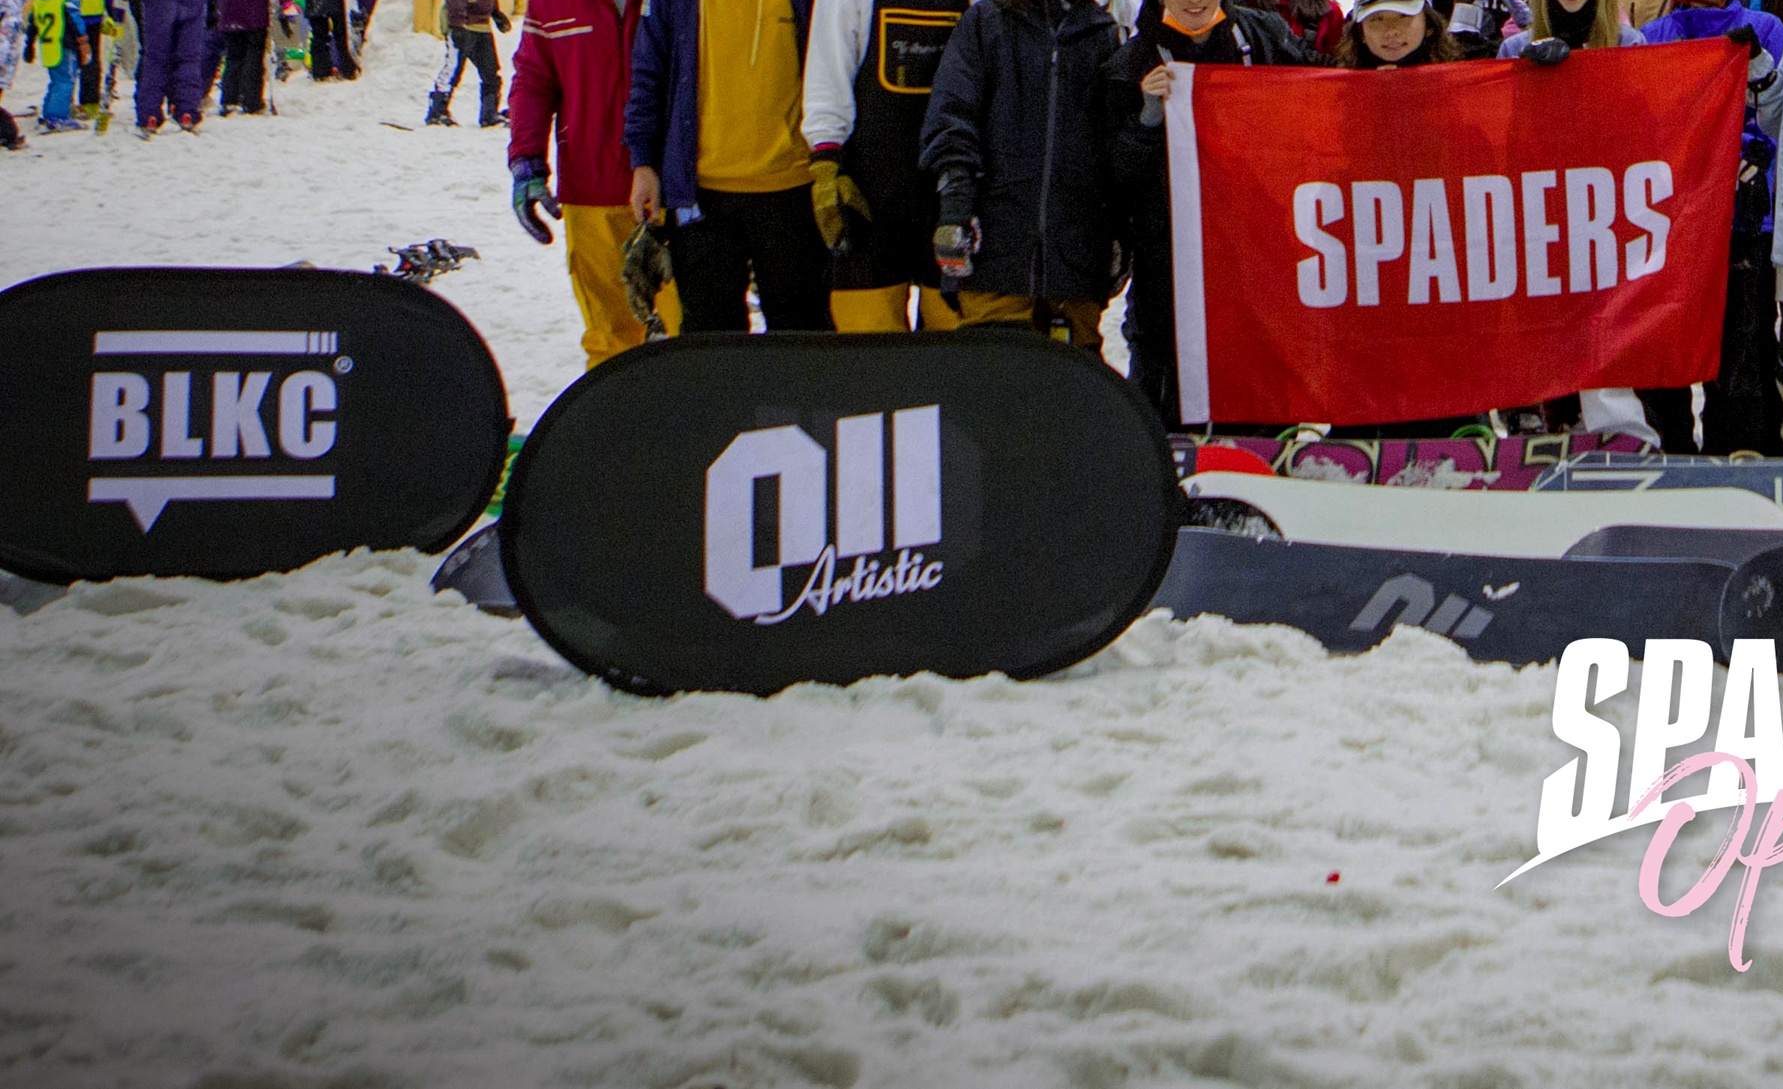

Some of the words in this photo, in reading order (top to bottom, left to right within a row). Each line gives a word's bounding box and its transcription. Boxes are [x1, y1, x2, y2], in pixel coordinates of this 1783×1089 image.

[1293, 161, 1675, 308] SPADERS
[88, 370, 338, 460] BLKC
[755, 544, 943, 625] Artistic
